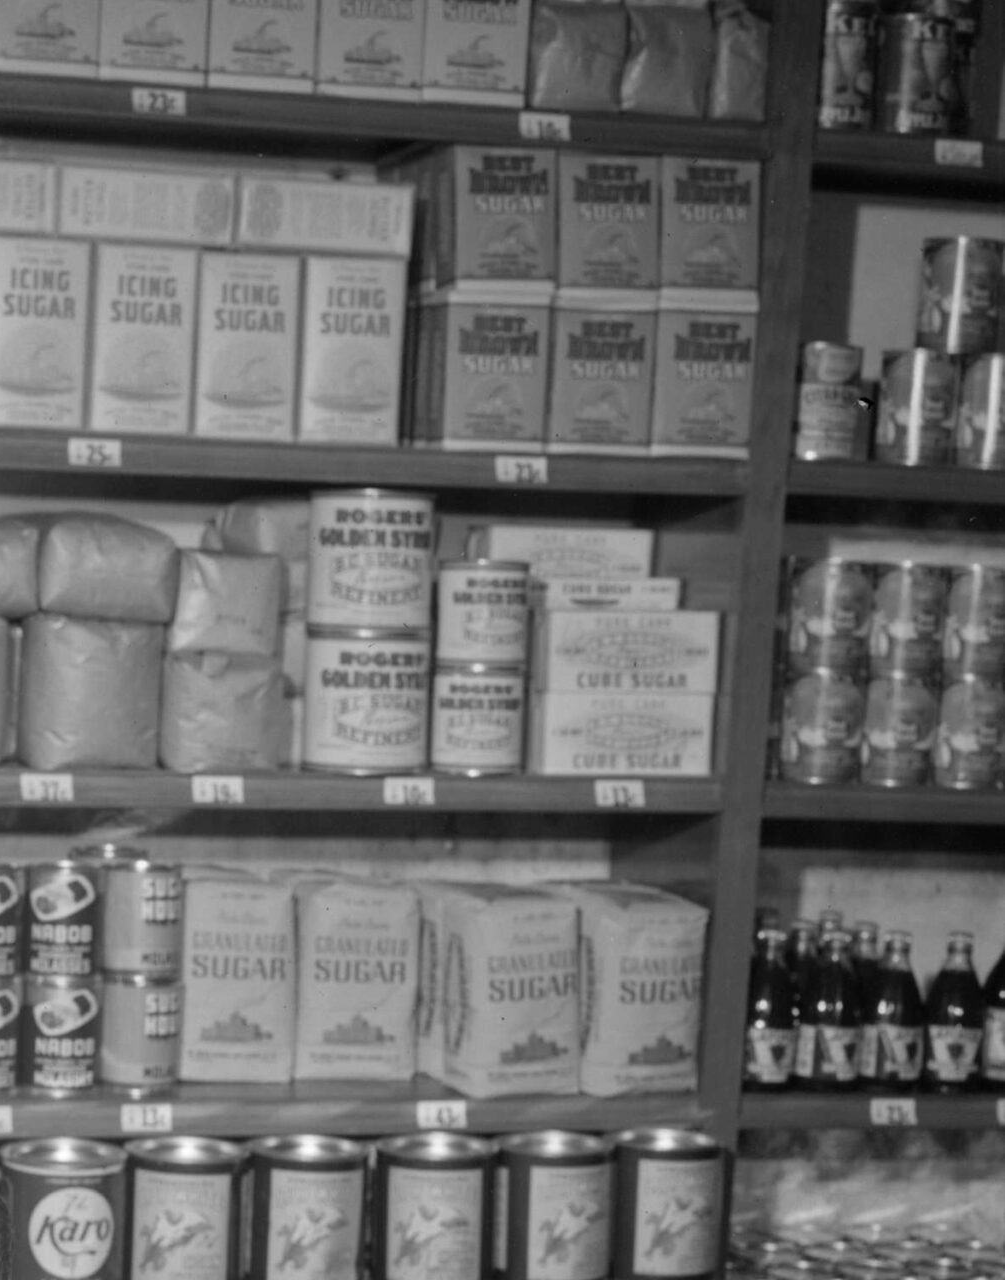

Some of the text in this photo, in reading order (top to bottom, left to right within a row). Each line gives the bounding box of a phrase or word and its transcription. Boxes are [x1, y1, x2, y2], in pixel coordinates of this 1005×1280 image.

[10, 267, 71, 292] ICING
[118, 273, 177, 299] ICING
[3, 293, 76, 320] SUGAR
[221, 282, 280, 307] ICING
[328, 286, 386, 310] ICING
[110, 300, 183, 327] SUGAR
[214, 308, 286, 334] SUGAR
[320, 311, 391, 337] SUGAR
[576, 672, 688, 689] CUBE SUGAR
[572, 754, 682, 770] CUBE SUGAR
[191, 955, 287, 982] SUGAR
[314, 959, 406, 985] SUGAR
[489, 972, 578, 1003] SUGAR
[35, 1214, 111, 1257] Karo
